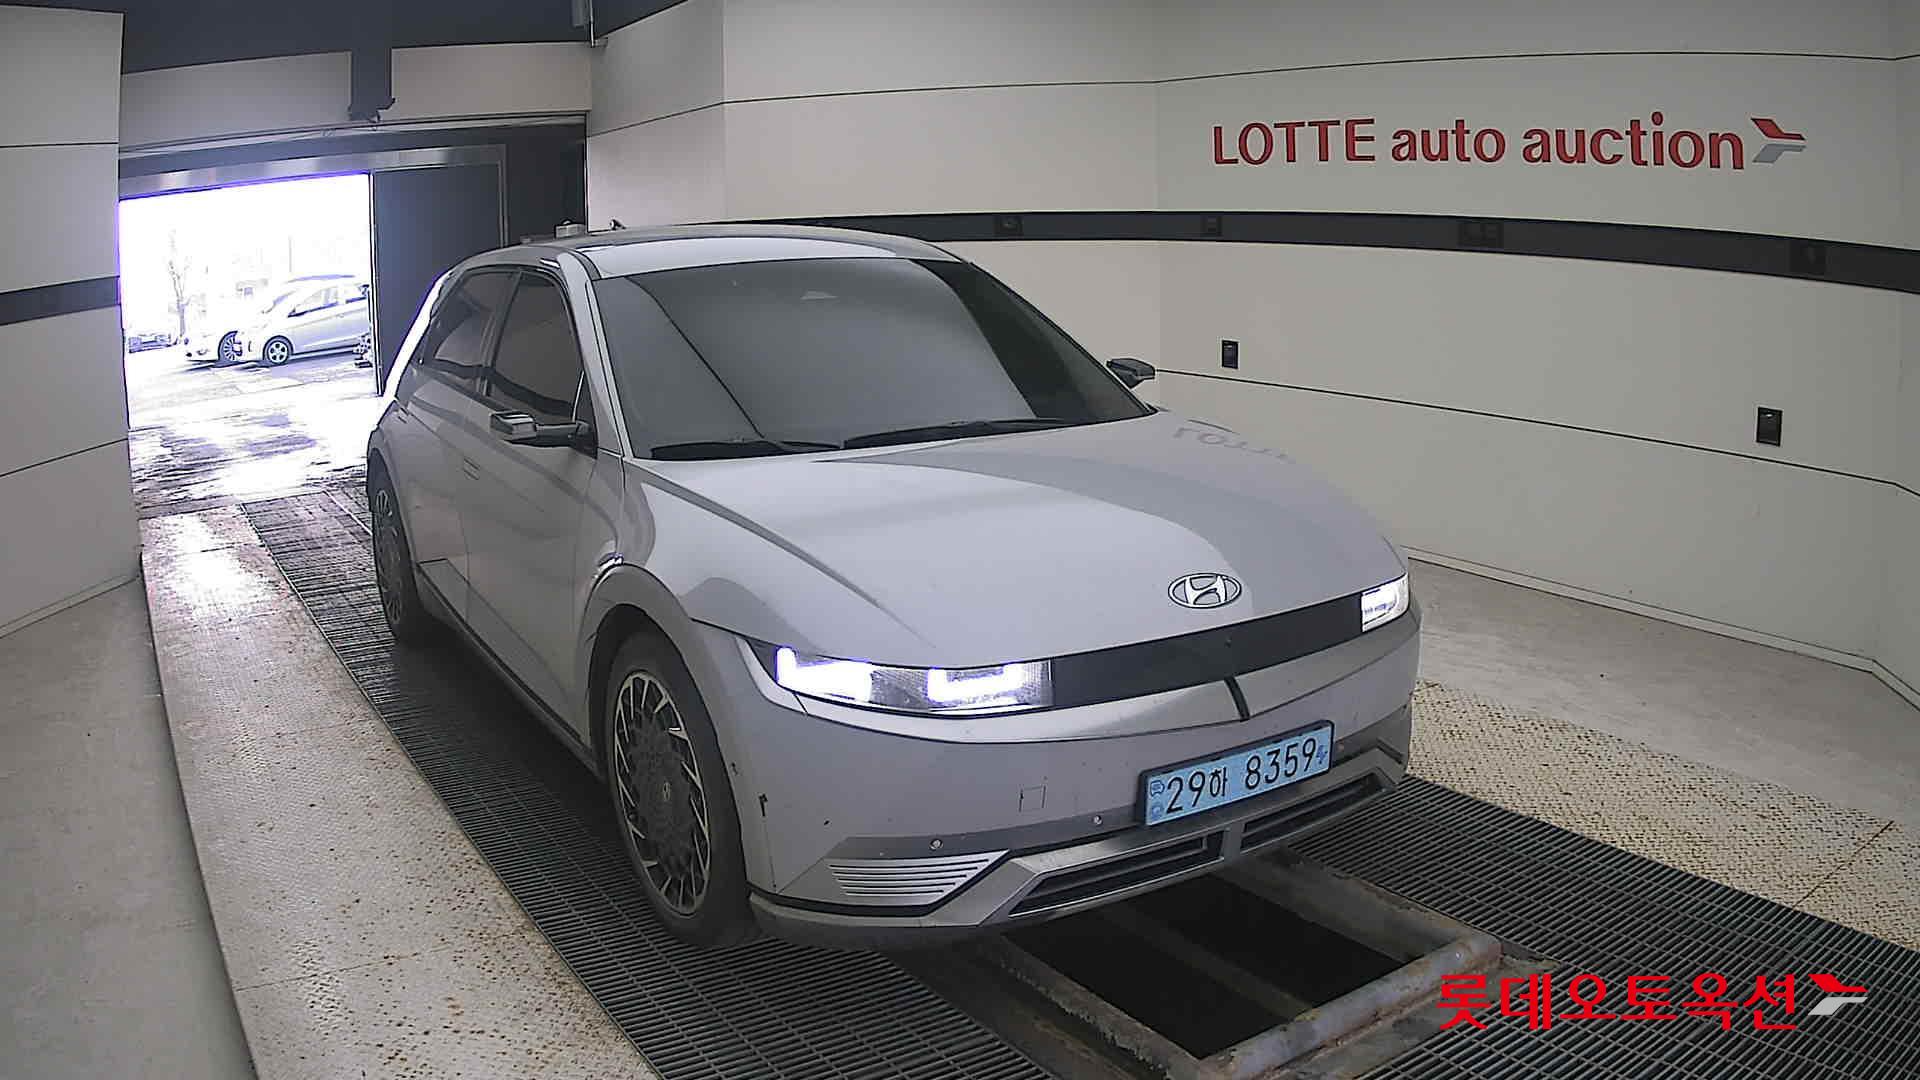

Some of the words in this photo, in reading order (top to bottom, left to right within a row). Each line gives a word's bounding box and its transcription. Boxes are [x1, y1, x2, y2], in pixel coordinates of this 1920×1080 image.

[1214, 119, 1376, 165] LOTTE
[1391, 119, 1506, 163] auto
[1522, 112, 1745, 169] auction
[1165, 767, 1228, 814] 29하
[1245, 738, 1317, 790] 8359
